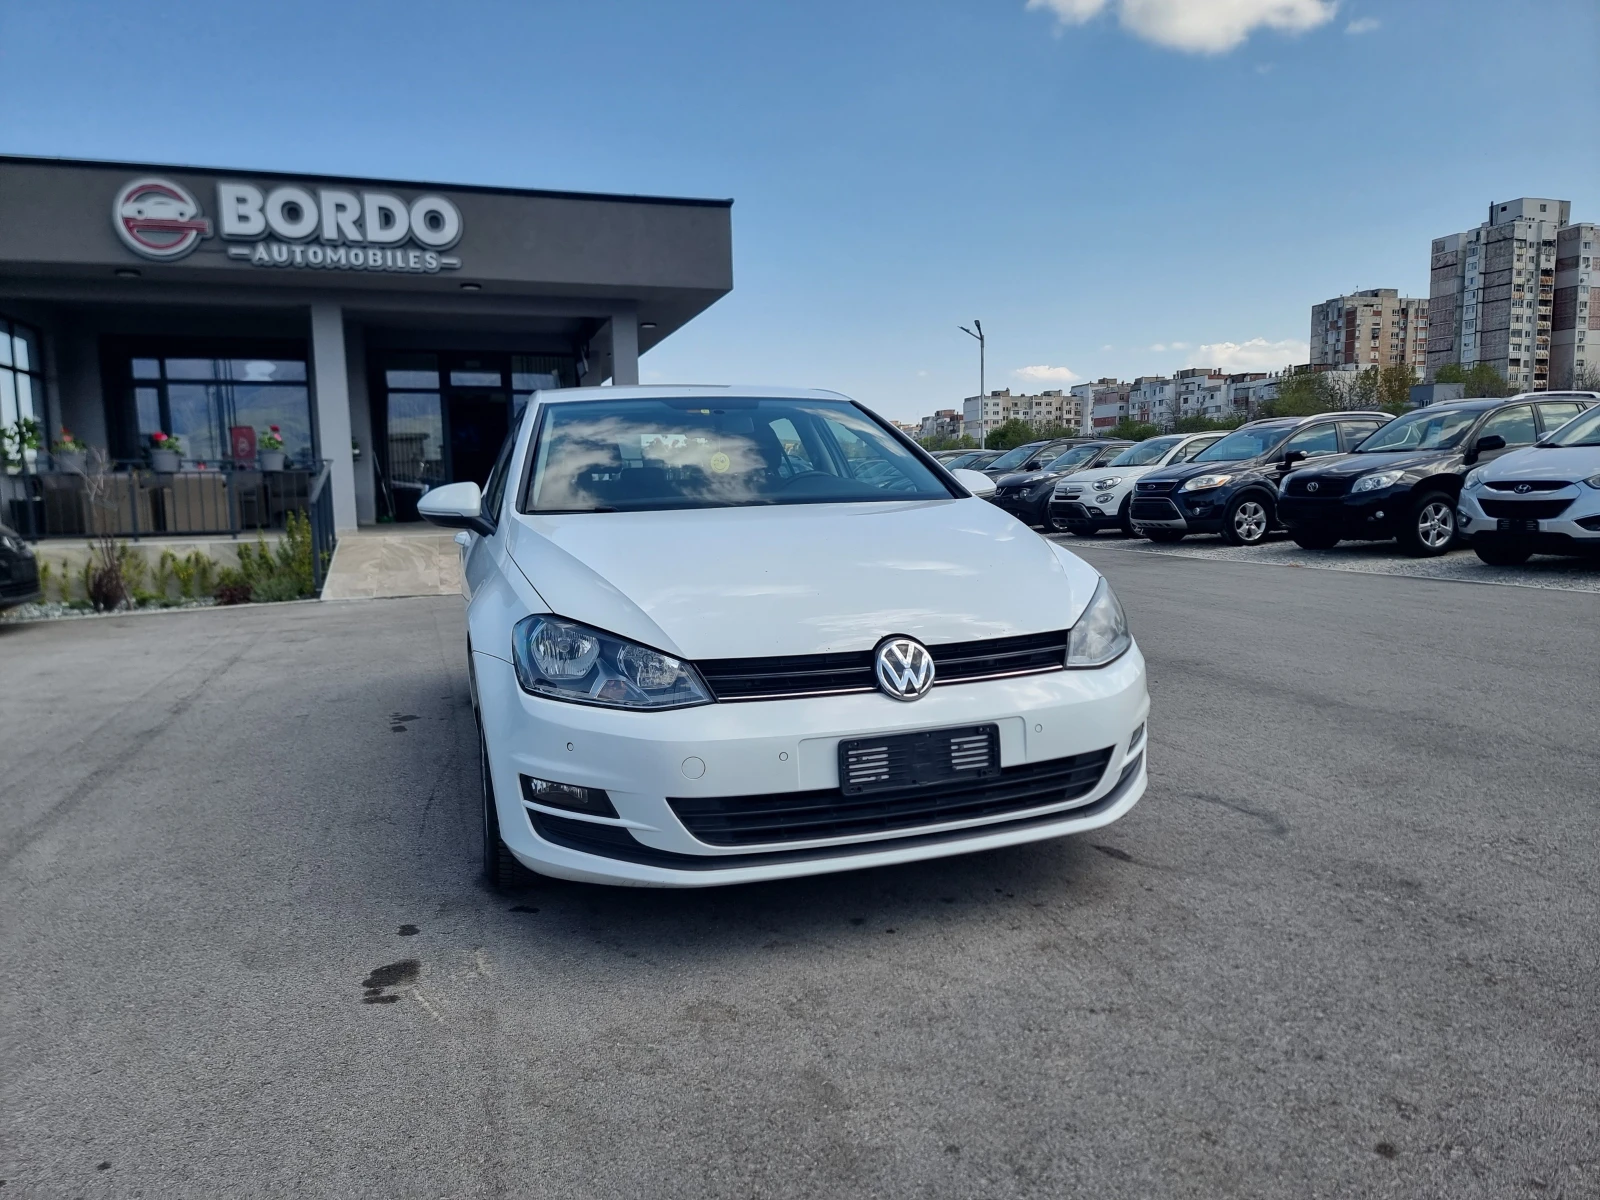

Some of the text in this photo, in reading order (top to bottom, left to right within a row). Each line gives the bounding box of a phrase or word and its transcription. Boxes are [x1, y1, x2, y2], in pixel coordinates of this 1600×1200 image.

[218, 183, 459, 246] BORDO
[254, 245, 438, 270] AUTOMOBILES
[878, 640, 934, 697] VW
